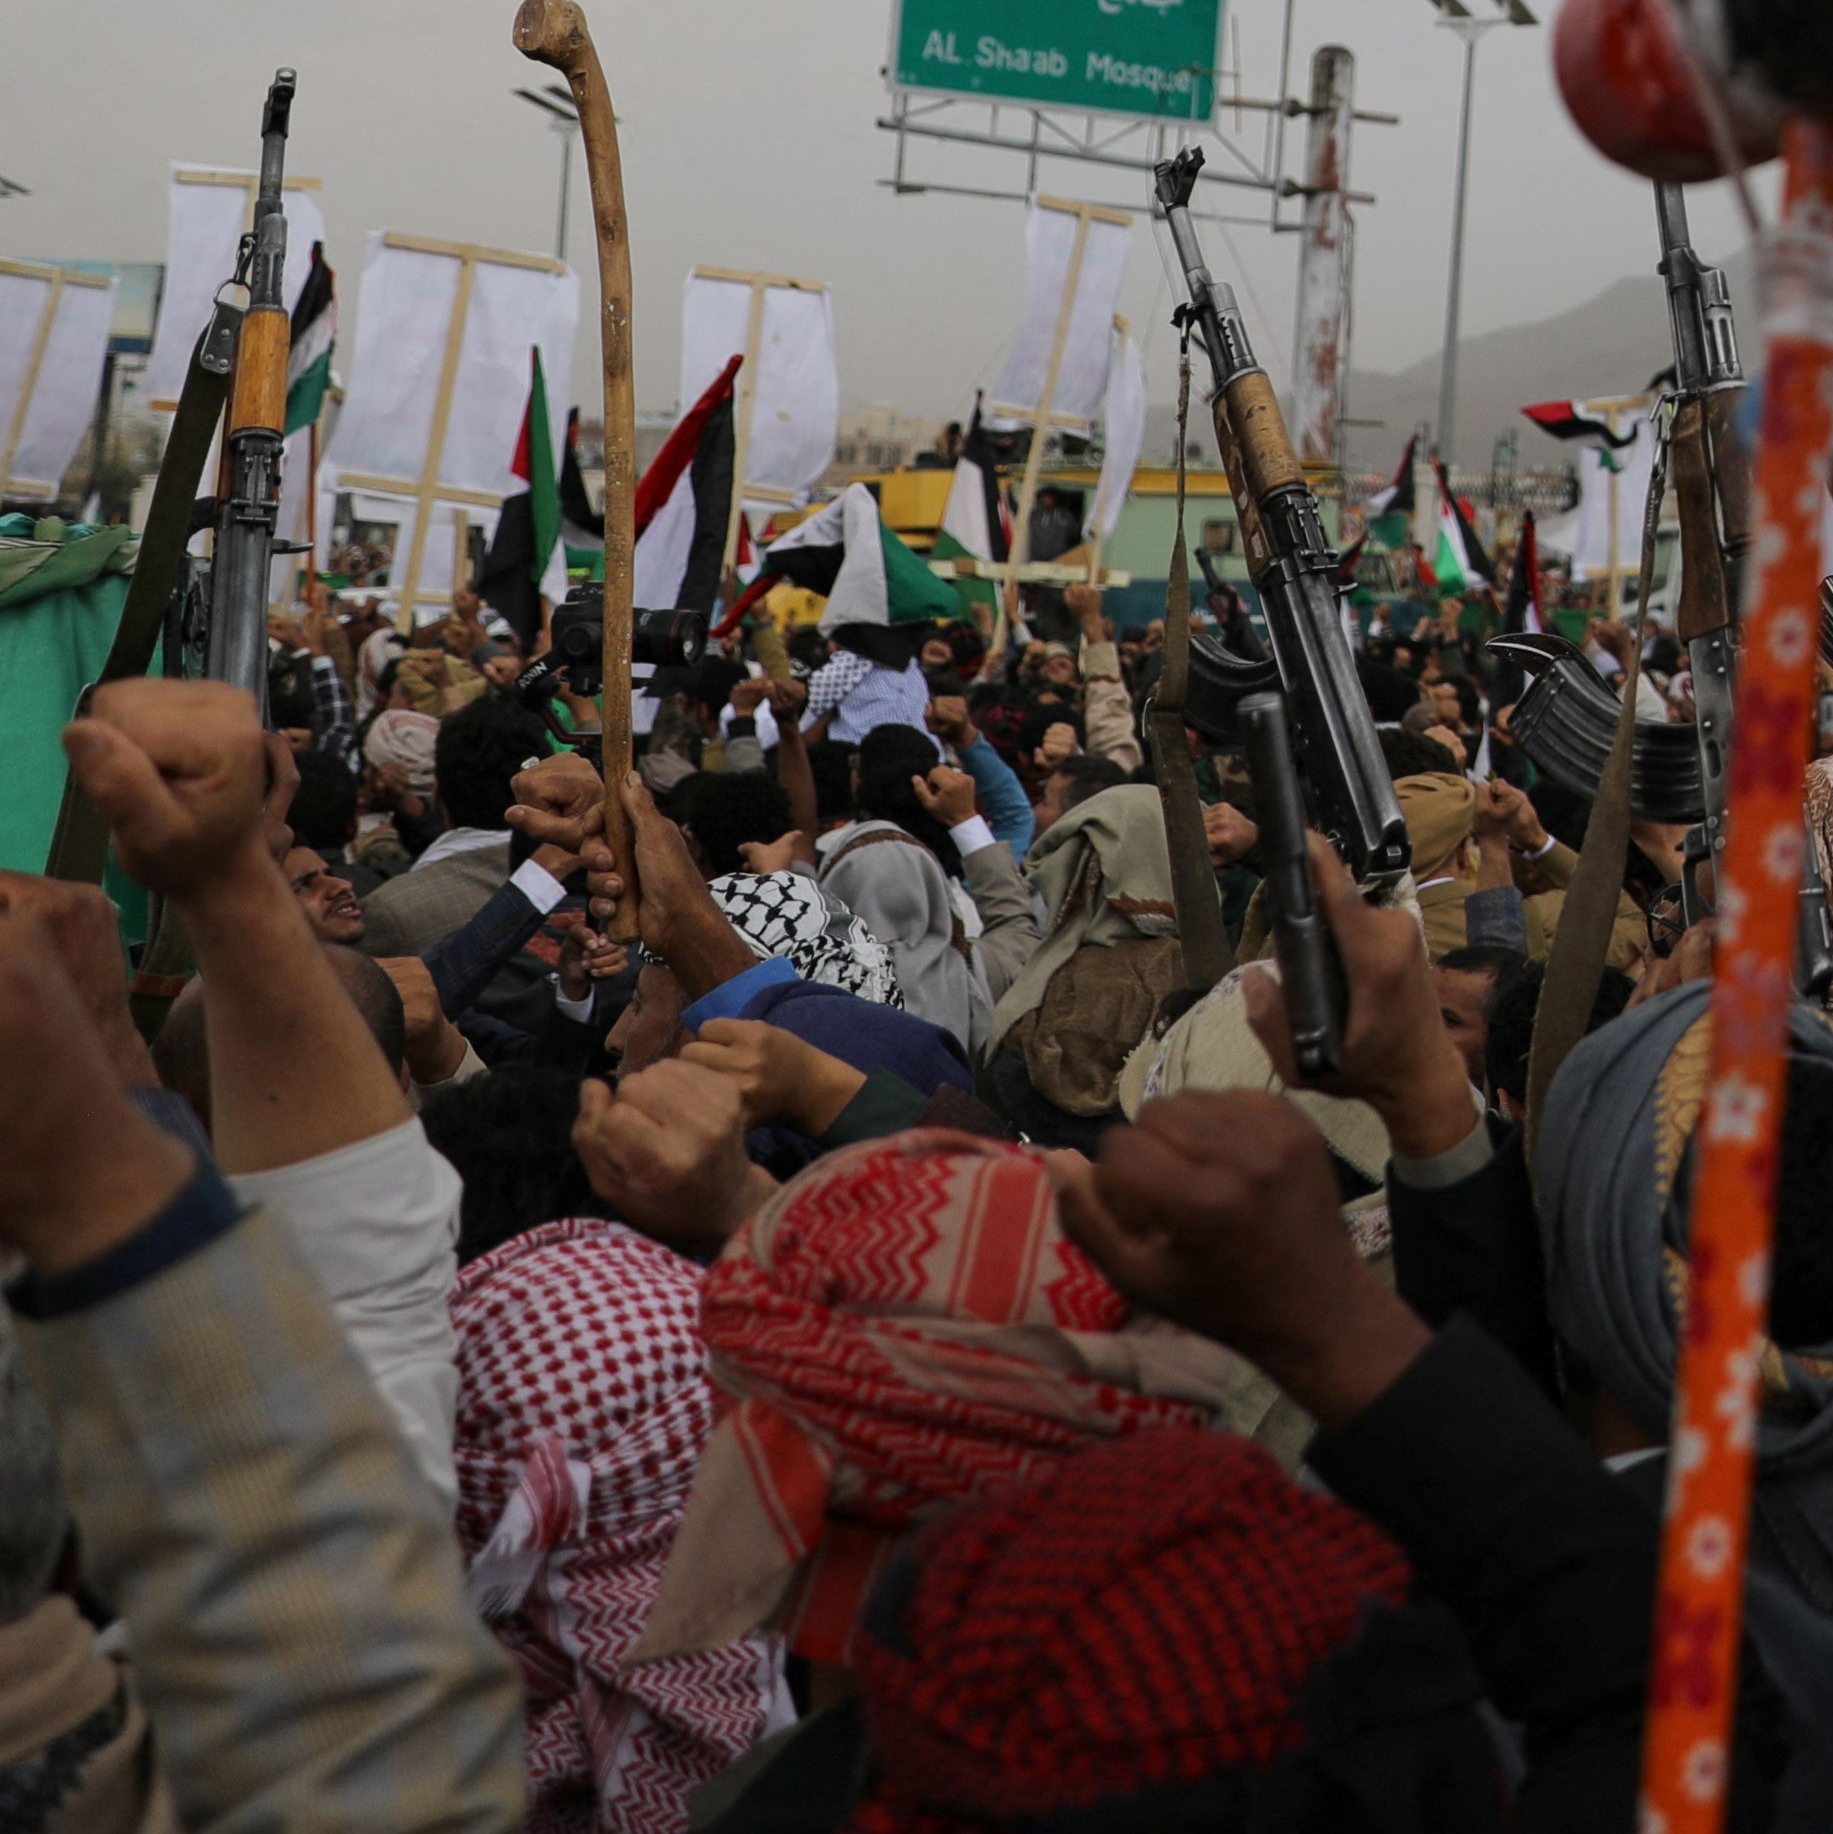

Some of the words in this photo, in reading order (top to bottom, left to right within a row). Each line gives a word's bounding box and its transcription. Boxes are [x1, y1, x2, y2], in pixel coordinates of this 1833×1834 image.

[921, 30, 962, 65] AL
[974, 35, 1069, 78] Shaab
[1085, 51, 1192, 94] Mosque
